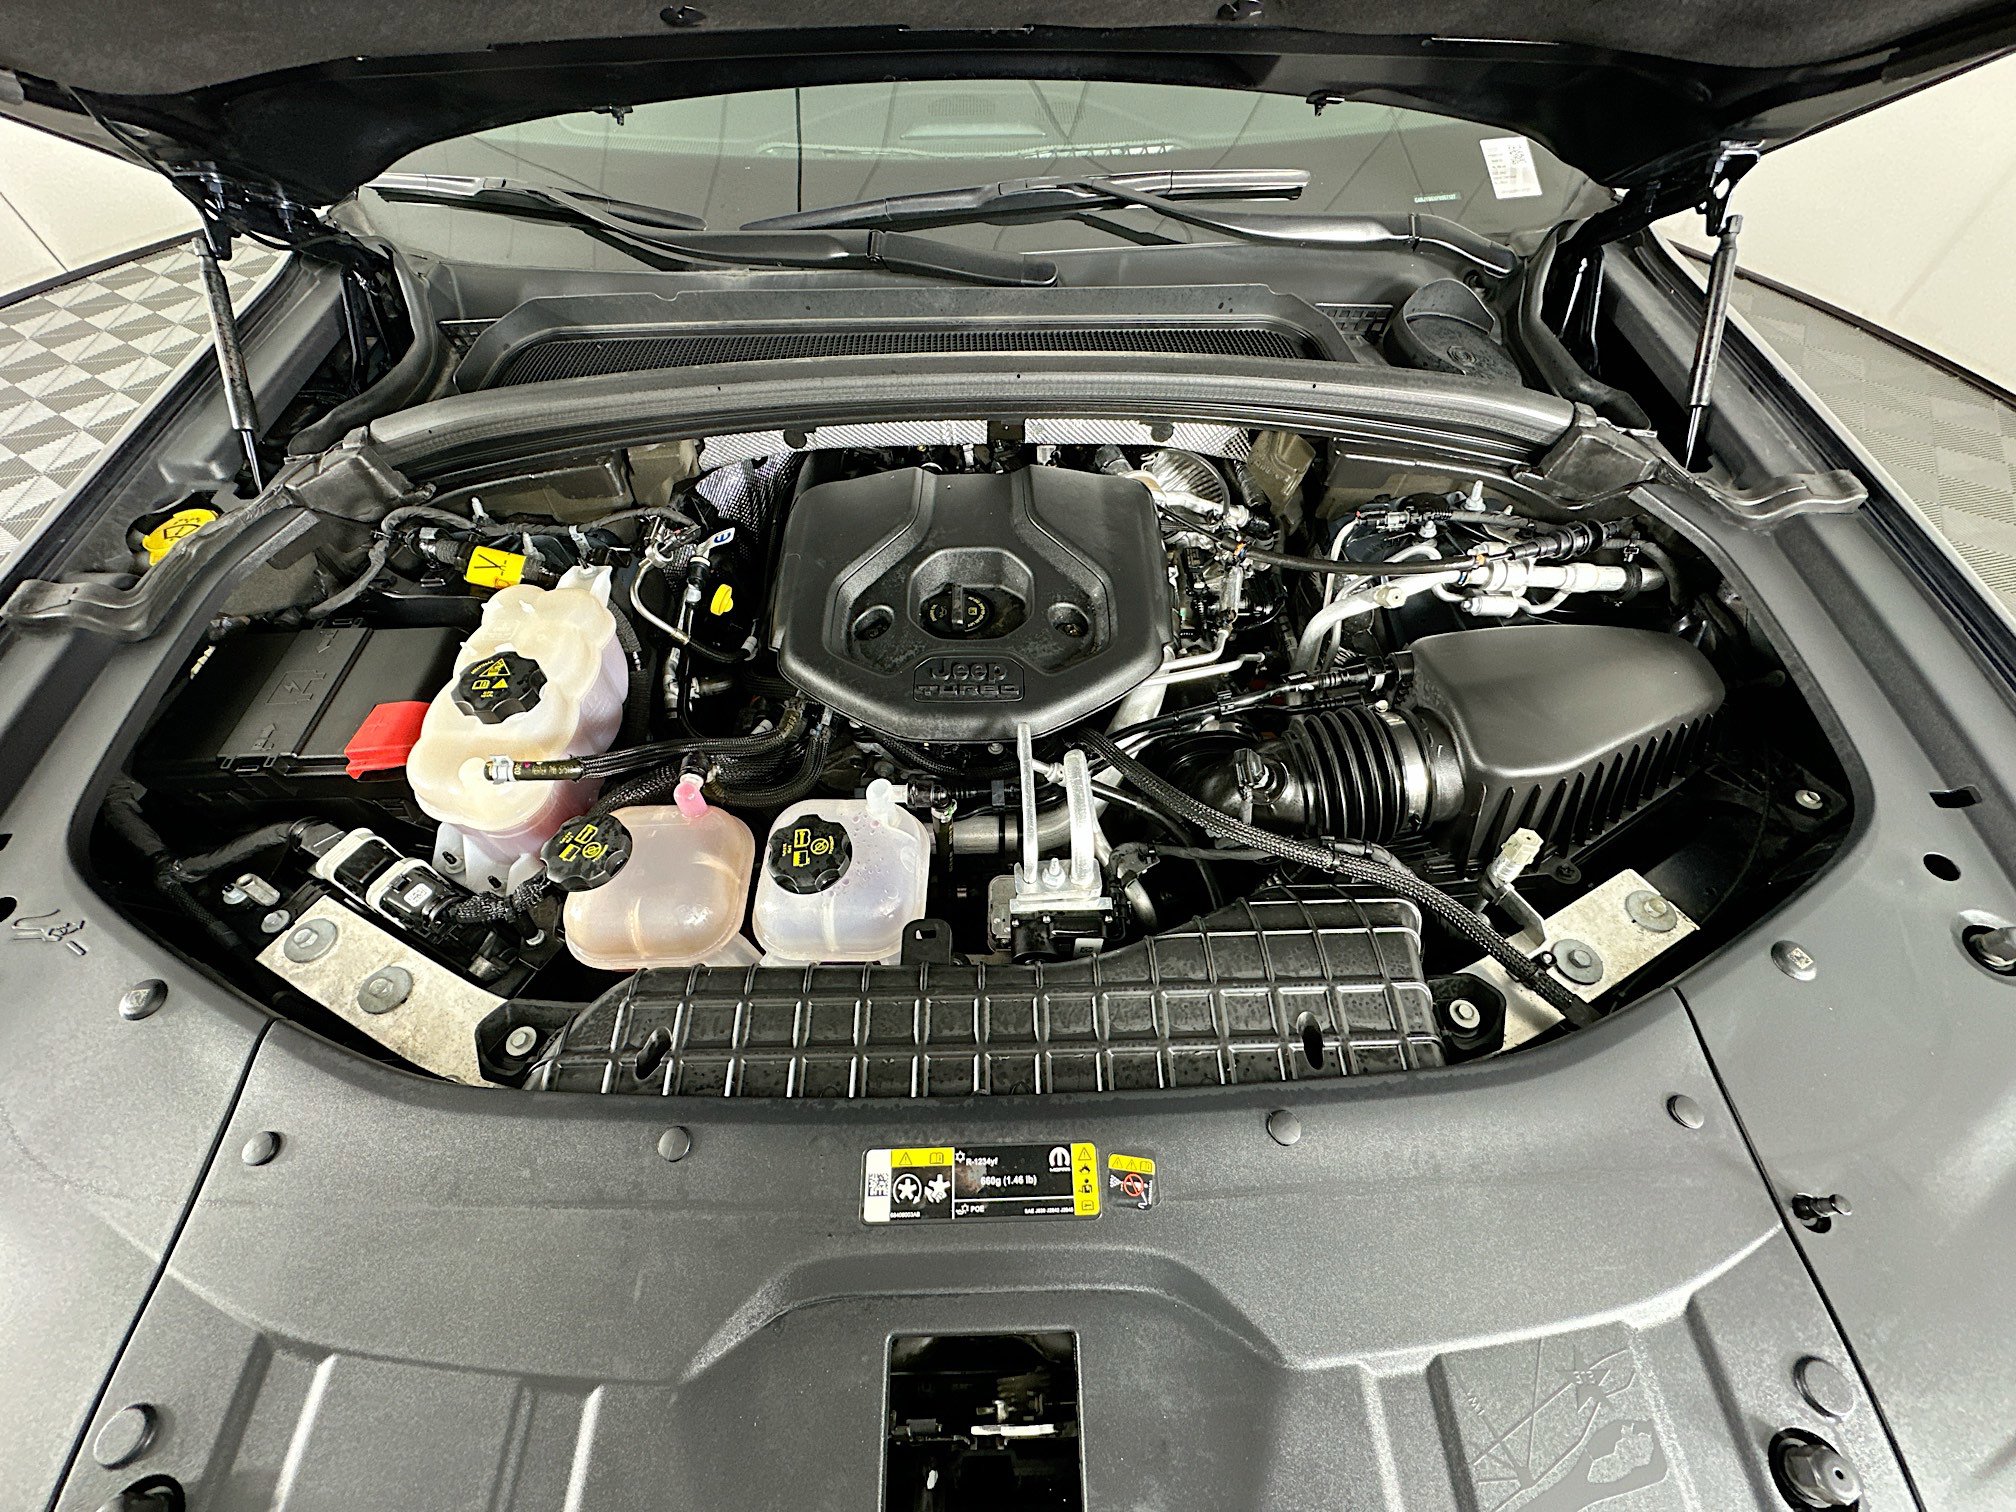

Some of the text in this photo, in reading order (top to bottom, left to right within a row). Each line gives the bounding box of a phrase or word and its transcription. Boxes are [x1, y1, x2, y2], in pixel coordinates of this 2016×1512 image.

[930, 658, 1008, 684] Jeep
[965, 1156, 999, 1168] R-1234yf
[980, 1174, 1038, 1188] 660g (1.46 lb)
[969, 1204, 985, 1213] POE
